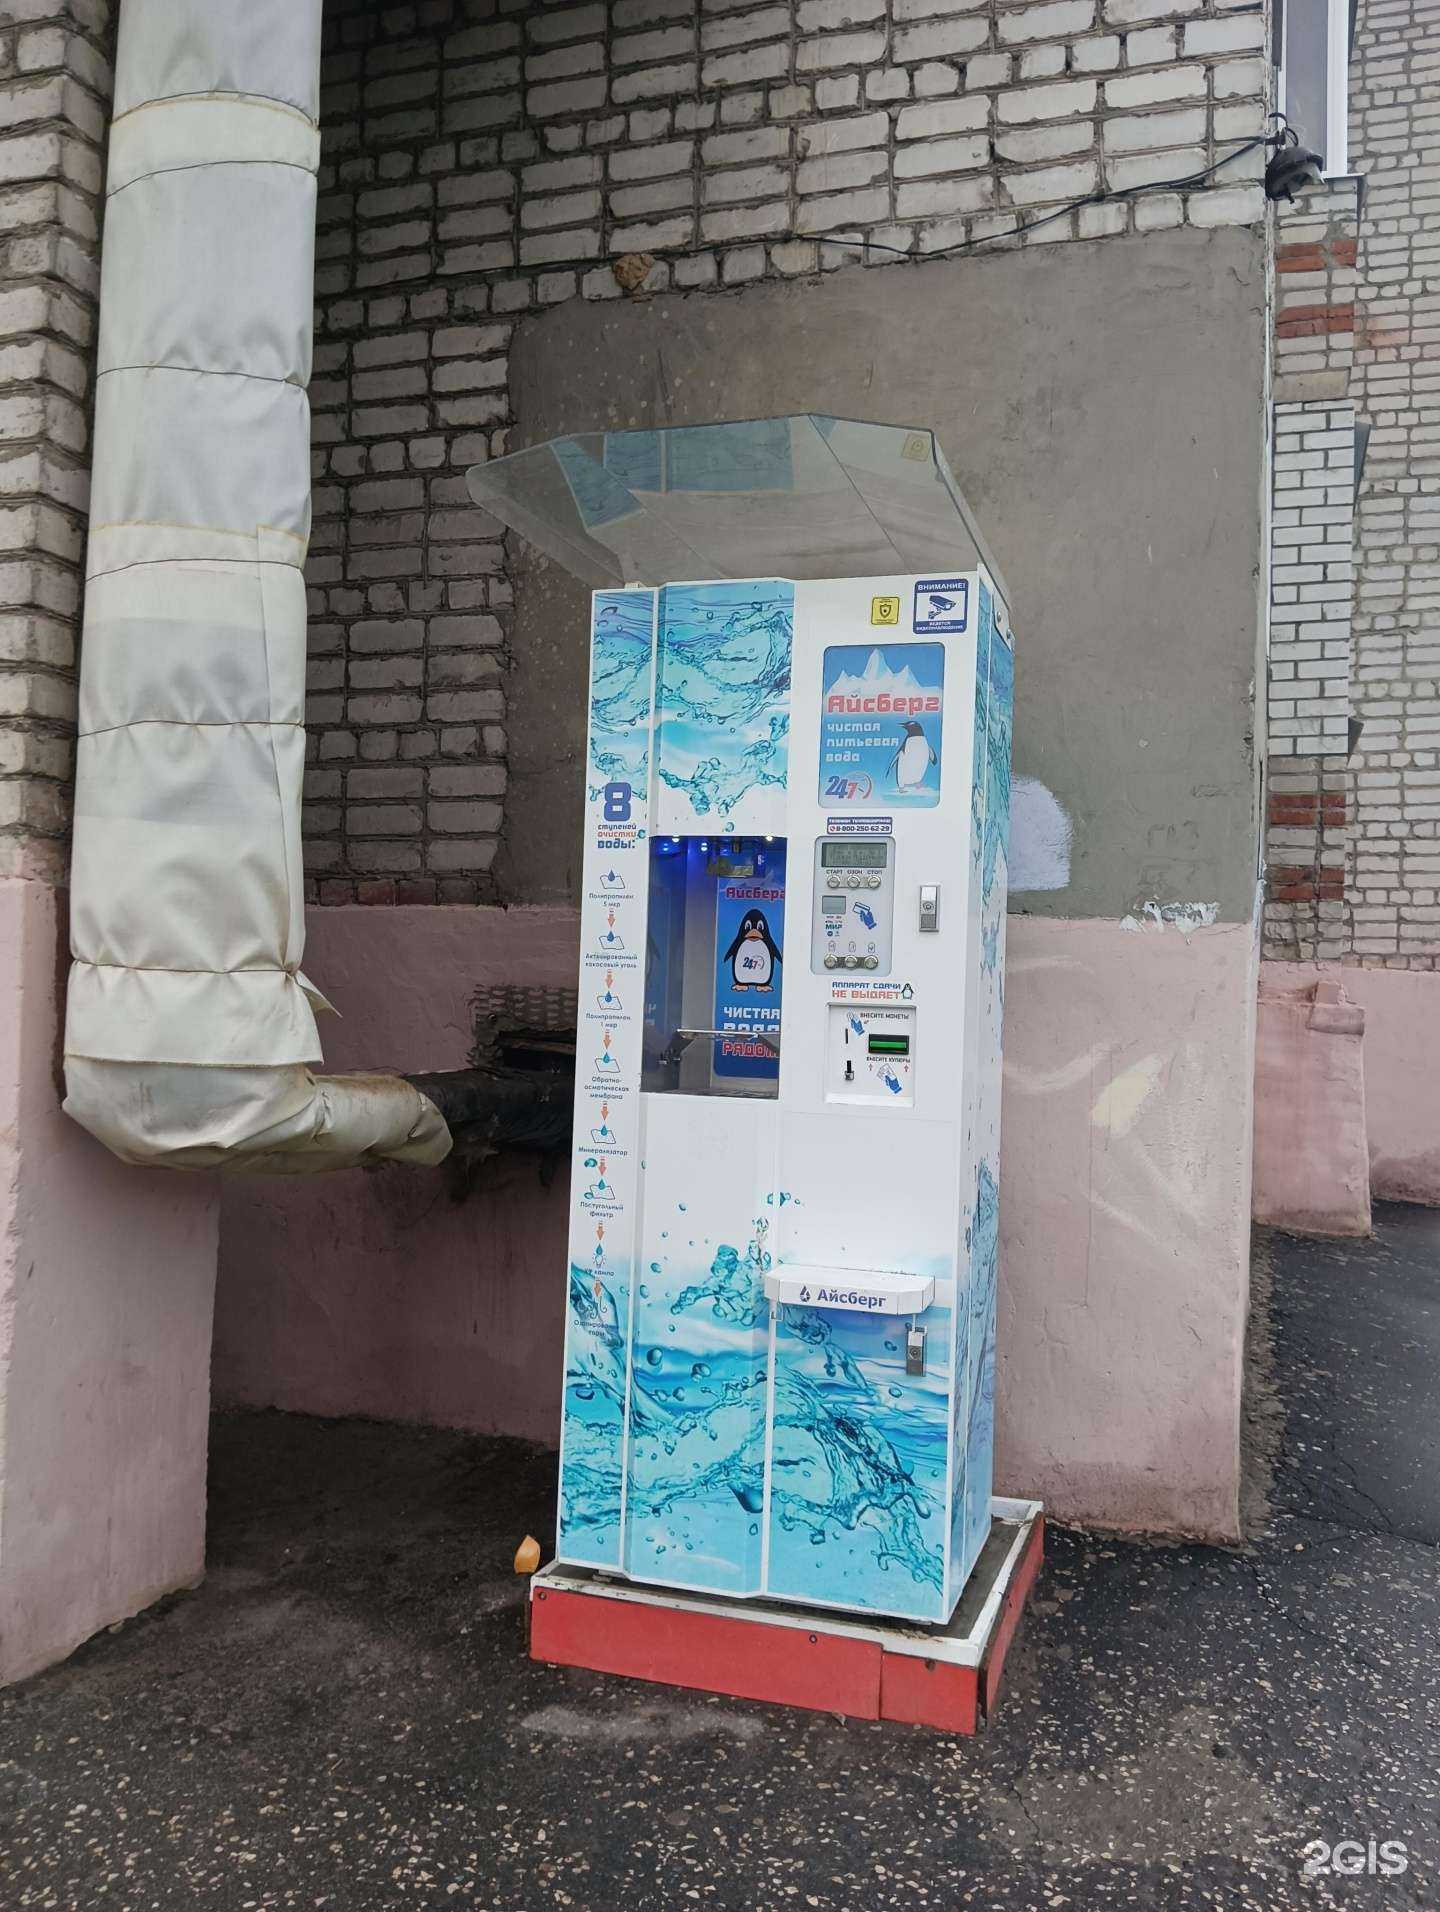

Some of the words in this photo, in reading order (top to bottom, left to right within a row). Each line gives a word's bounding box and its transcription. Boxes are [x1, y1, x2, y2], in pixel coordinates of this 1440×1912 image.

[918, 582, 966, 591] ВНИМАНИЕ!
[828, 694, 940, 715] Айсберг
[827, 722, 881, 732] чистая
[826, 736, 899, 747] питьевая
[825, 751, 860, 762] вода
[604, 782, 632, 821] 8
[598, 823, 637, 831] ступеней
[832, 981, 870, 989] АППАРАТ
[873, 982, 901, 990] СДАЧИ
[832, 990, 847, 998] НЕ
[851, 990, 901, 999] ВЫДАЕТ
[723, 1006, 780, 1020] ЧИСТАЯ
[817, 1289, 886, 1309] Айсберг
